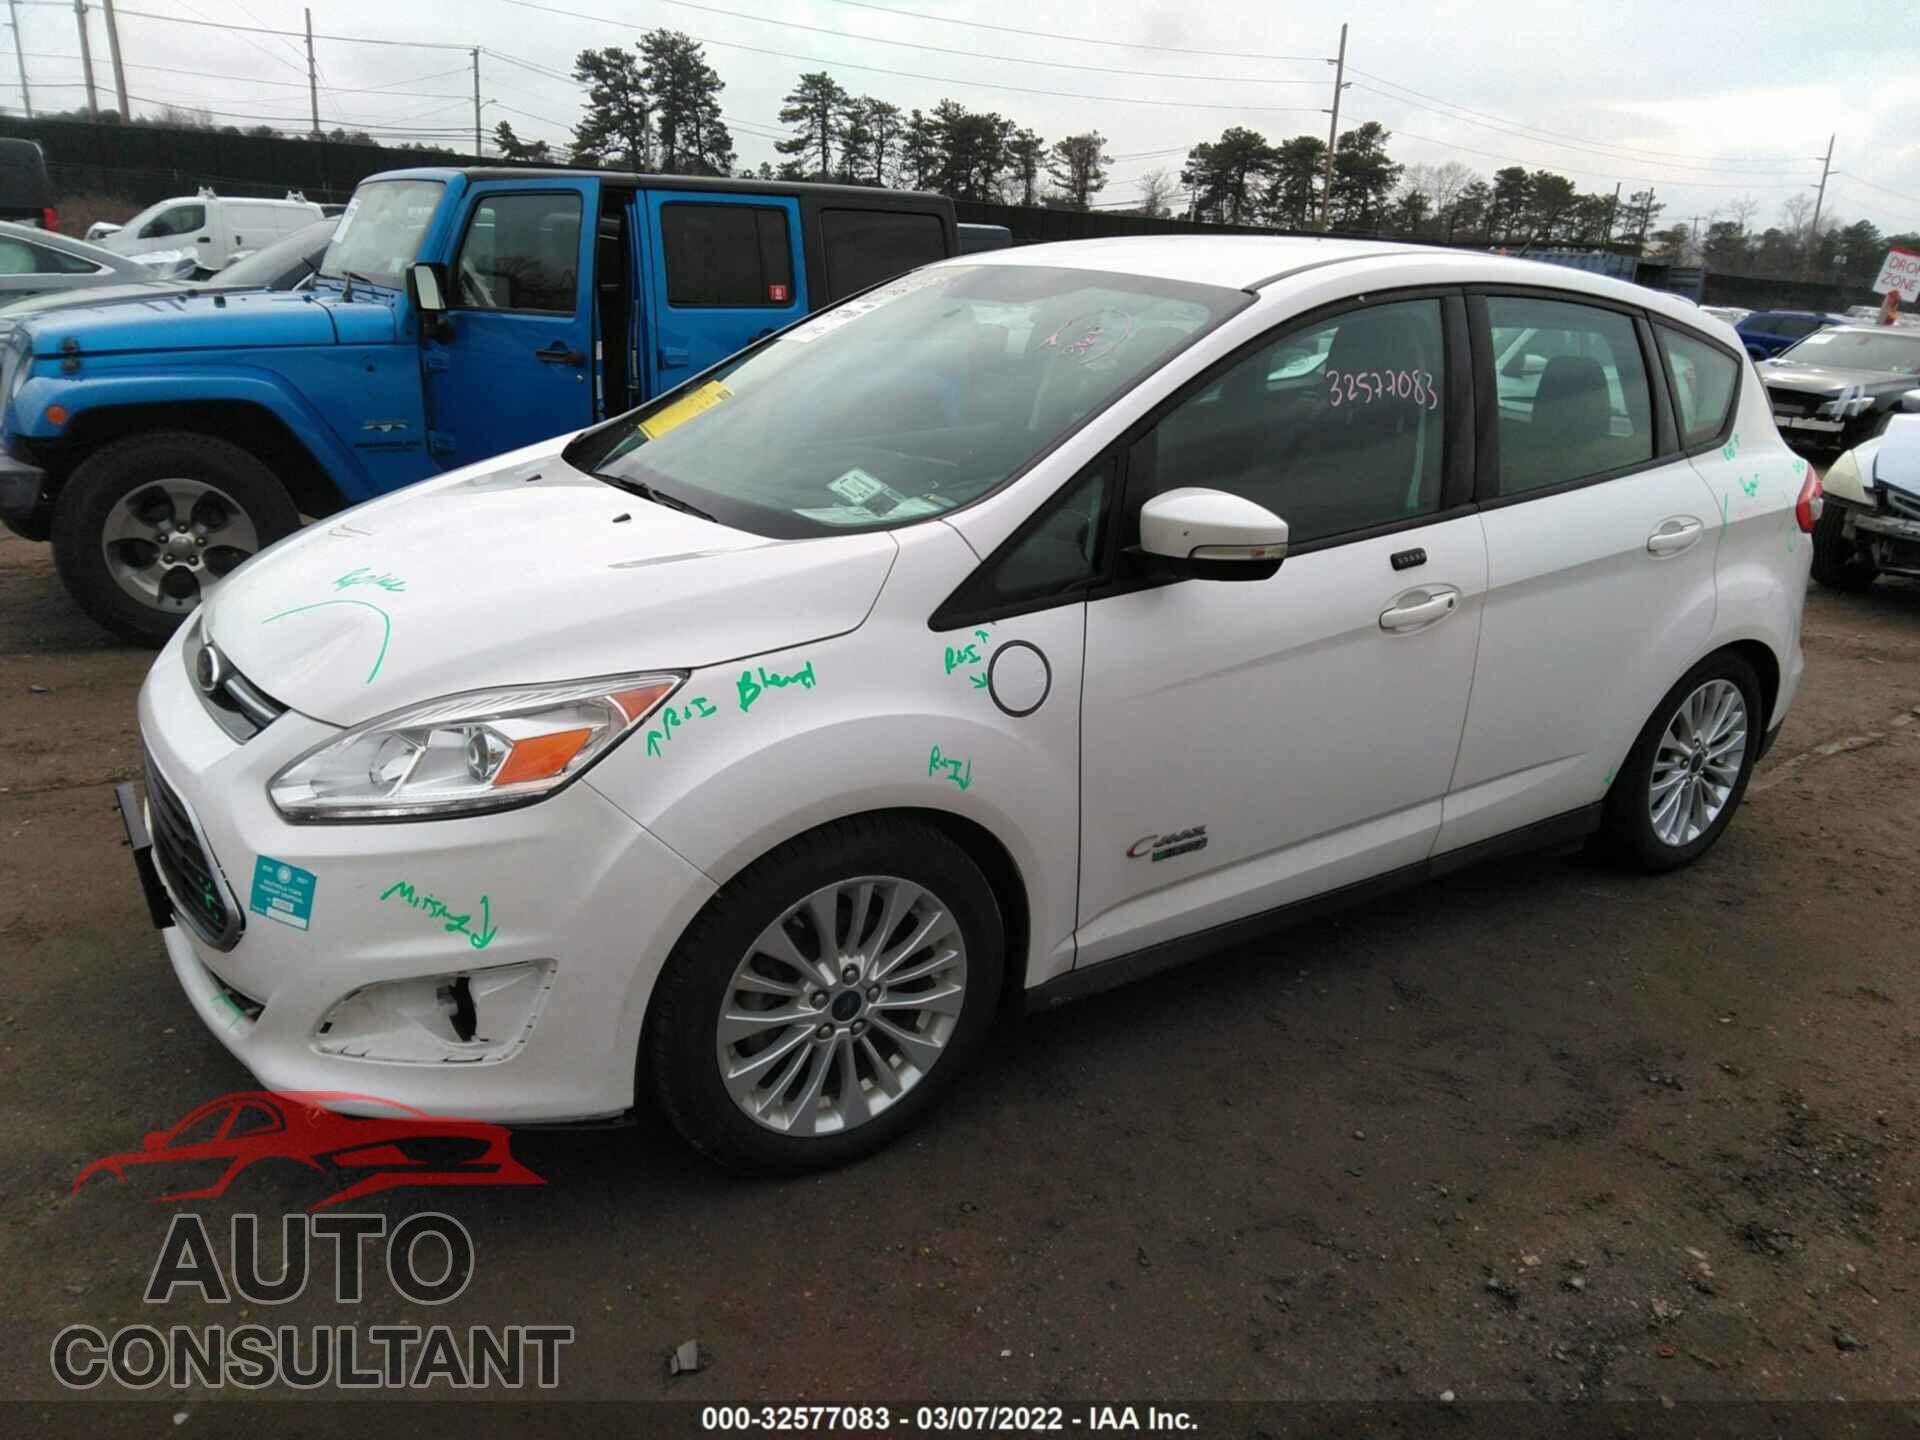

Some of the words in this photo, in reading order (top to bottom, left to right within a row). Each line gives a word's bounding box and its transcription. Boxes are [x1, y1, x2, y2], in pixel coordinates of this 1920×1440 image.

[1881, 272, 1918, 291] ZONE
[1326, 368, 1438, 410] 32577083
[736, 661, 816, 712] Blend
